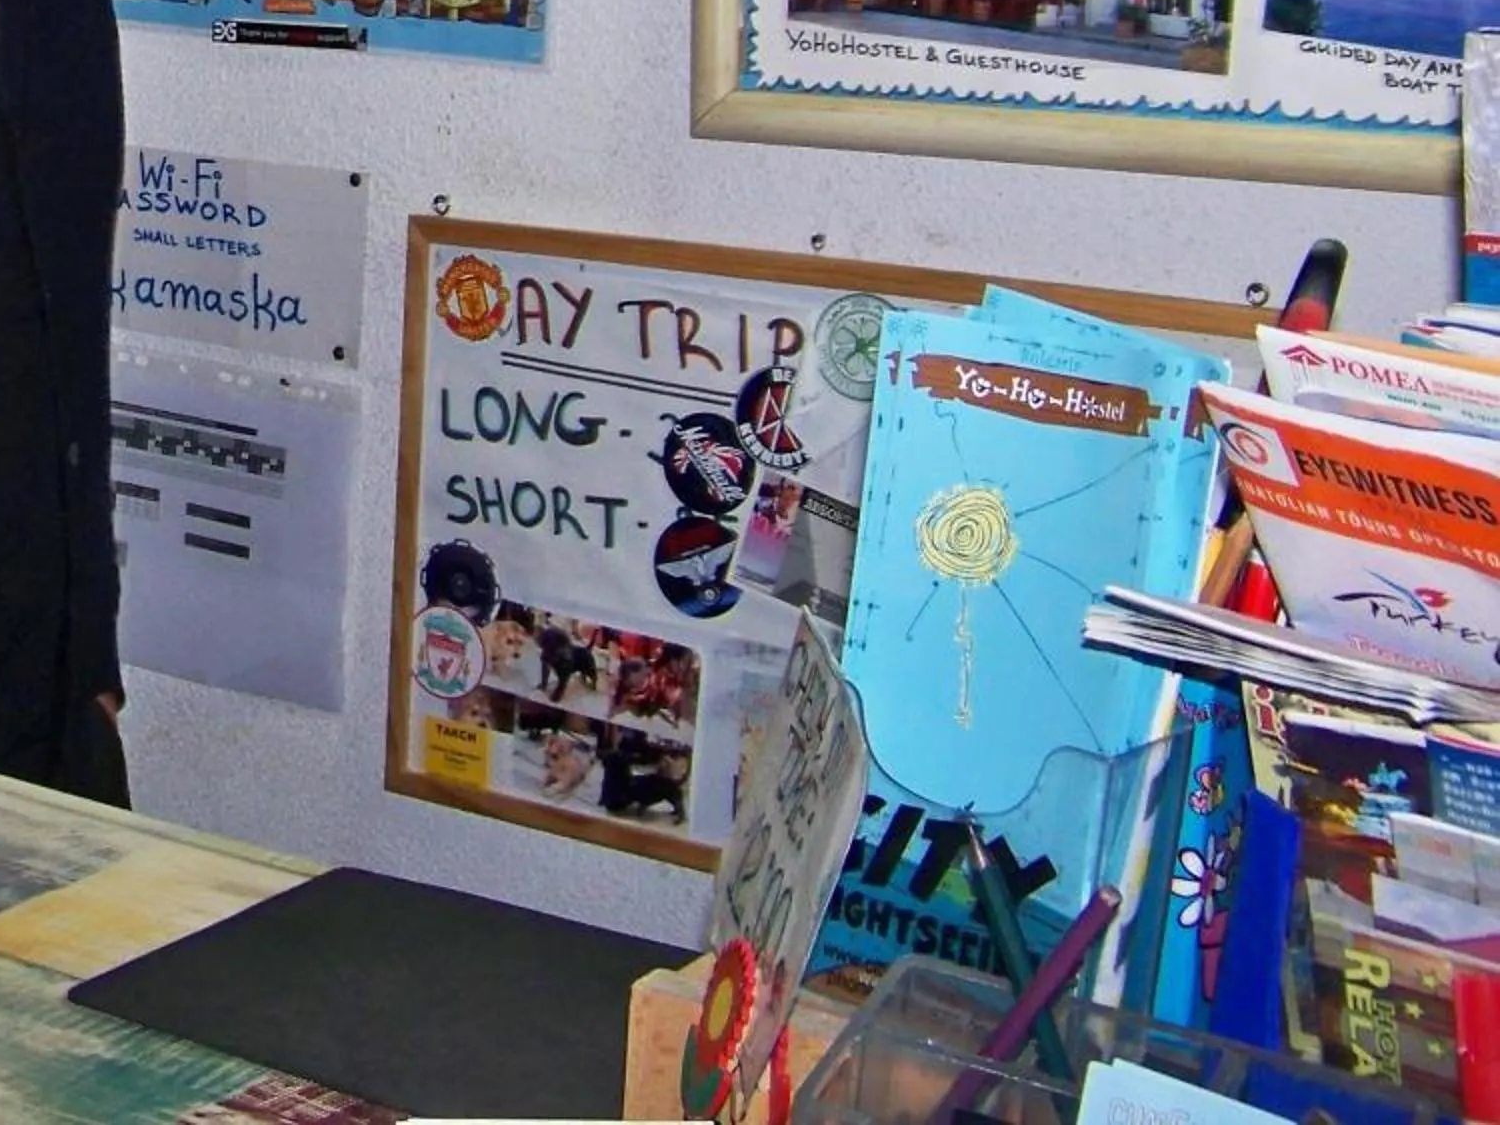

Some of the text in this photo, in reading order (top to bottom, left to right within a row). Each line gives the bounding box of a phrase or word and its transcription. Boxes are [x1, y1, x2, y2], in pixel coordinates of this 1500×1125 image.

[925, 45, 939, 64] &
[945, 47, 1087, 81] GUESTHOUSE
[1299, 39, 1377, 65] GUIDED
[1382, 52, 1423, 72] DAY
[1382, 72, 1440, 93] BOAT
[138, 150, 224, 201] Wi-Fi
[115, 189, 268, 228] ASSWORD
[133, 227, 263, 258] SMALL LETTERS
[513, 277, 594, 350] AY
[953, 363, 1127, 424] Yo-Ho-Hostel
[1291, 446, 1498, 527] EYEWITNESS
[1335, 509, 1404, 541] TOURS
